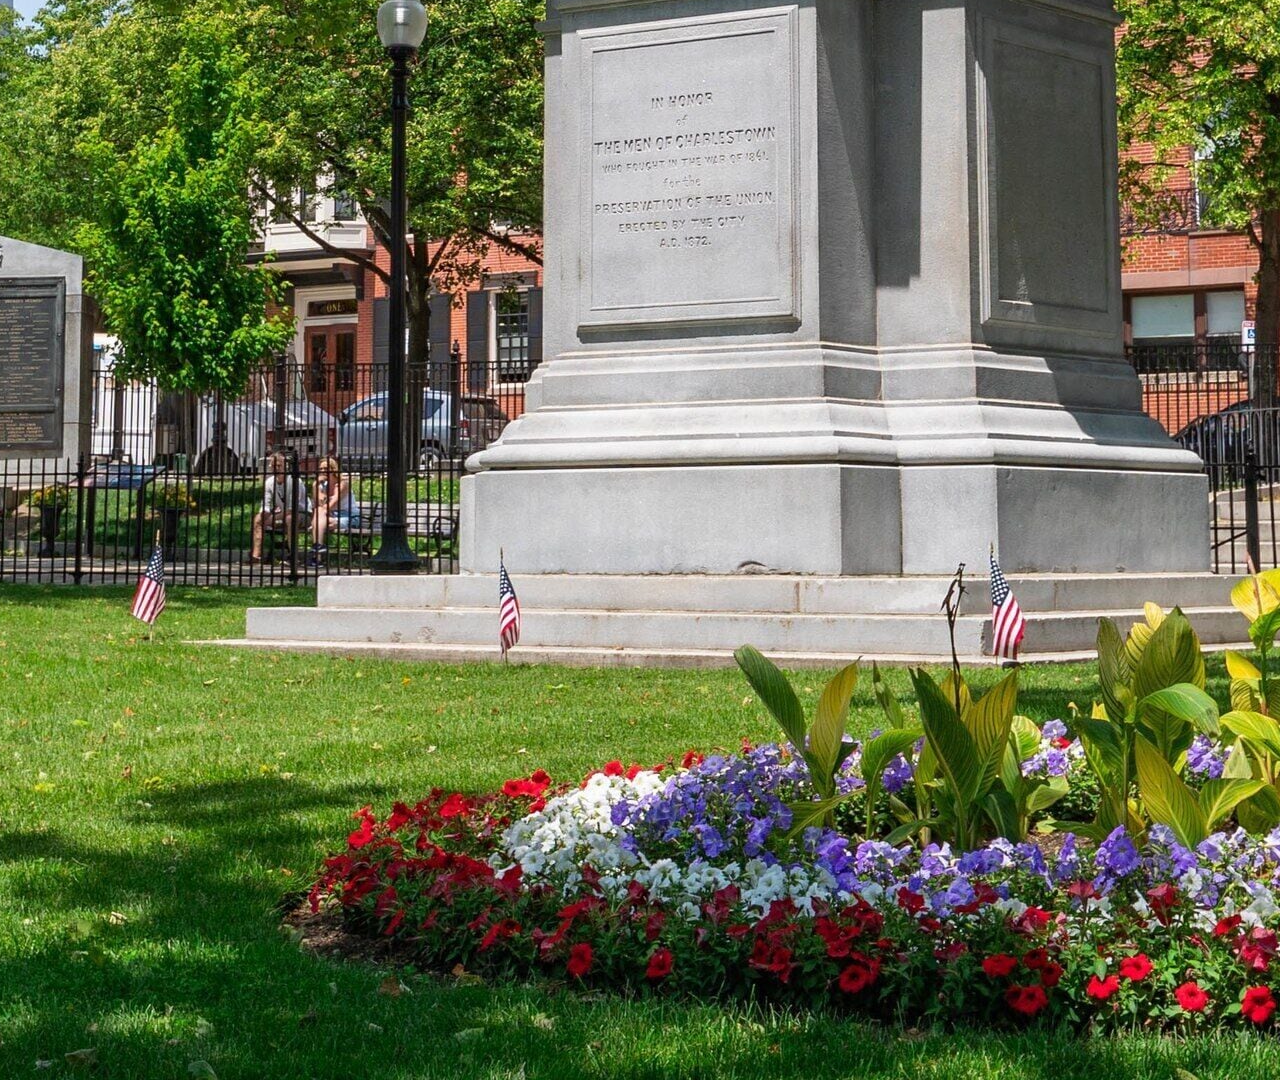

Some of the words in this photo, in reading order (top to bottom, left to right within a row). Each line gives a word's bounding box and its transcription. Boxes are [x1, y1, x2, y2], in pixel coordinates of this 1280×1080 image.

[651, 97, 664, 110] IN
[669, 92, 713, 109] HONOR
[594, 140, 621, 156] THE
[624, 136, 652, 154] MEN
[655, 135, 673, 151] OF
[675, 126, 776, 150] CHARLESTOWN
[601, 163, 623, 175] WHO
[626, 160, 666, 173] FOUGHT
[668, 159, 678, 169] IN
[681, 156, 702, 168] THE
[704, 154, 726, 166] WAR
[730, 152, 743, 164] OF
[594, 198, 682, 216] PRESERVATION
[686, 196, 702, 209] OF
[705, 193, 732, 208] THE
[618, 221, 668, 235] ERECTED
[672, 219, 686, 231] BY
[690, 217, 713, 230] THE
[717, 215, 745, 228] CITY
